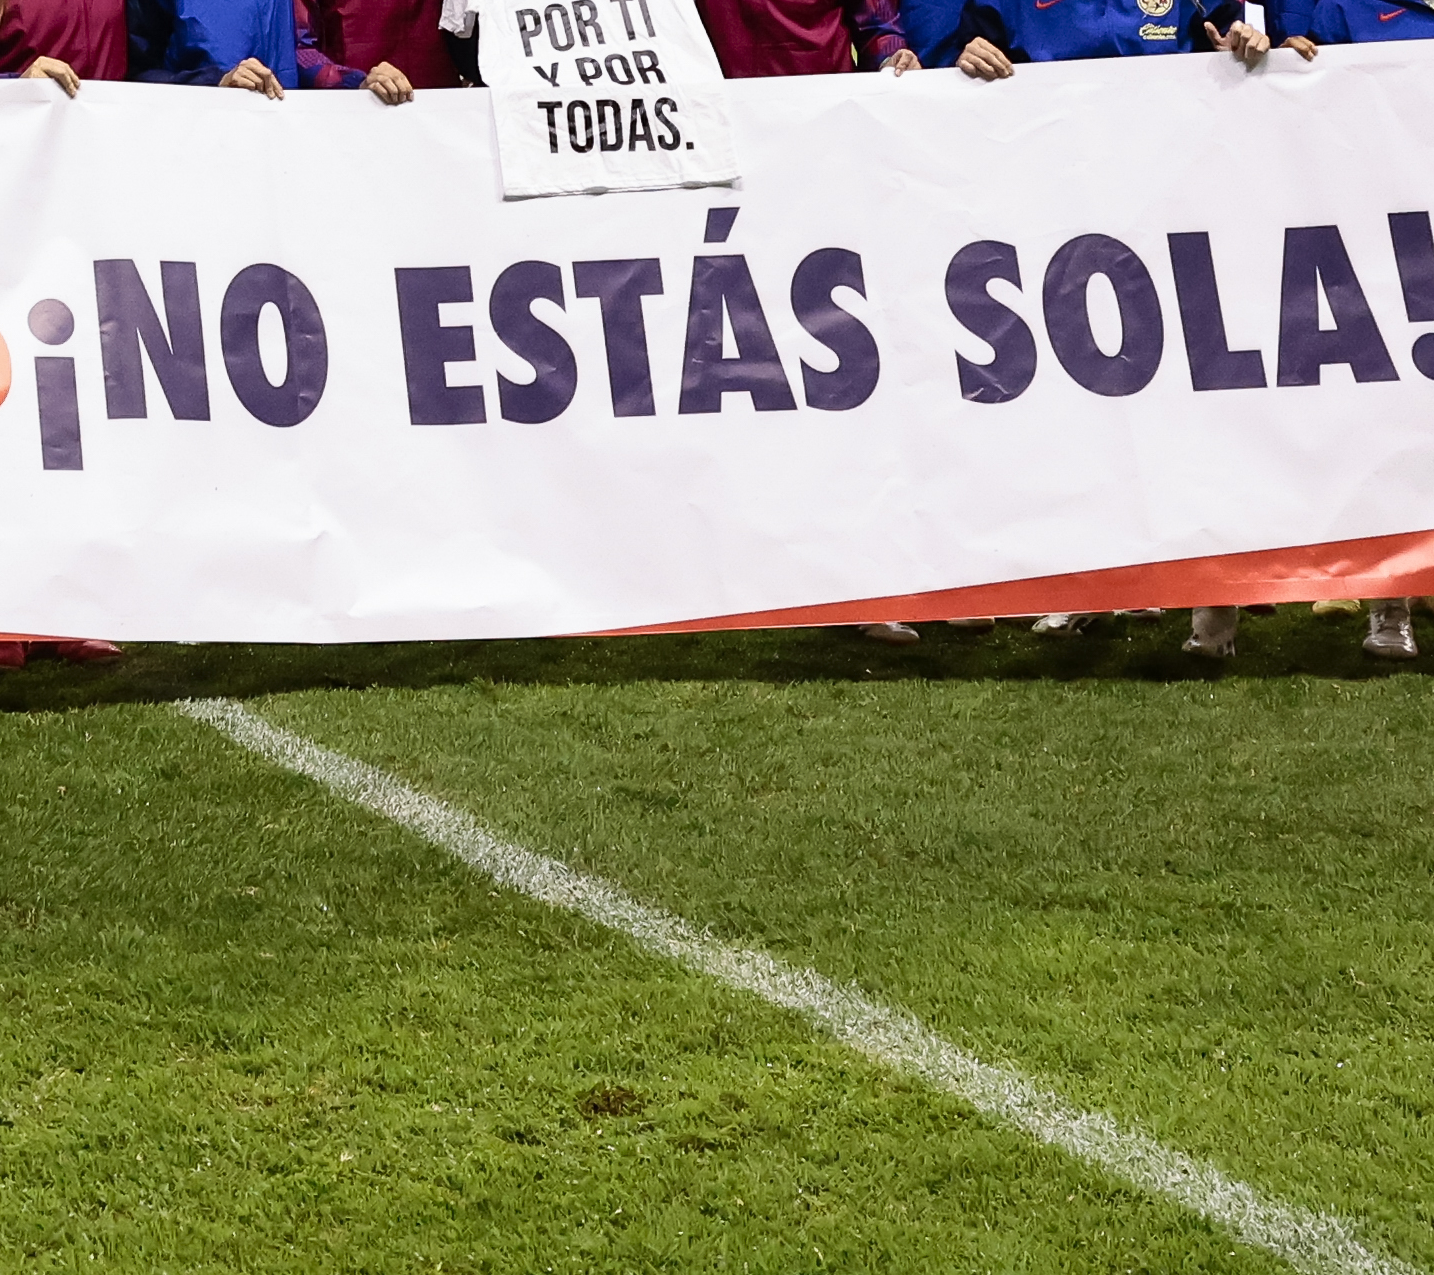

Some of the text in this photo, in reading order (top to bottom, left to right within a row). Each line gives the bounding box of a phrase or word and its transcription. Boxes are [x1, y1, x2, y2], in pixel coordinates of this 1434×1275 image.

[515, 0, 607, 57] POR
[532, 49, 666, 88] Y POR
[537, 96, 695, 154] TODAS.
[27, 257, 330, 471] ¡NO
[395, 207, 880, 425] ESTÁS
